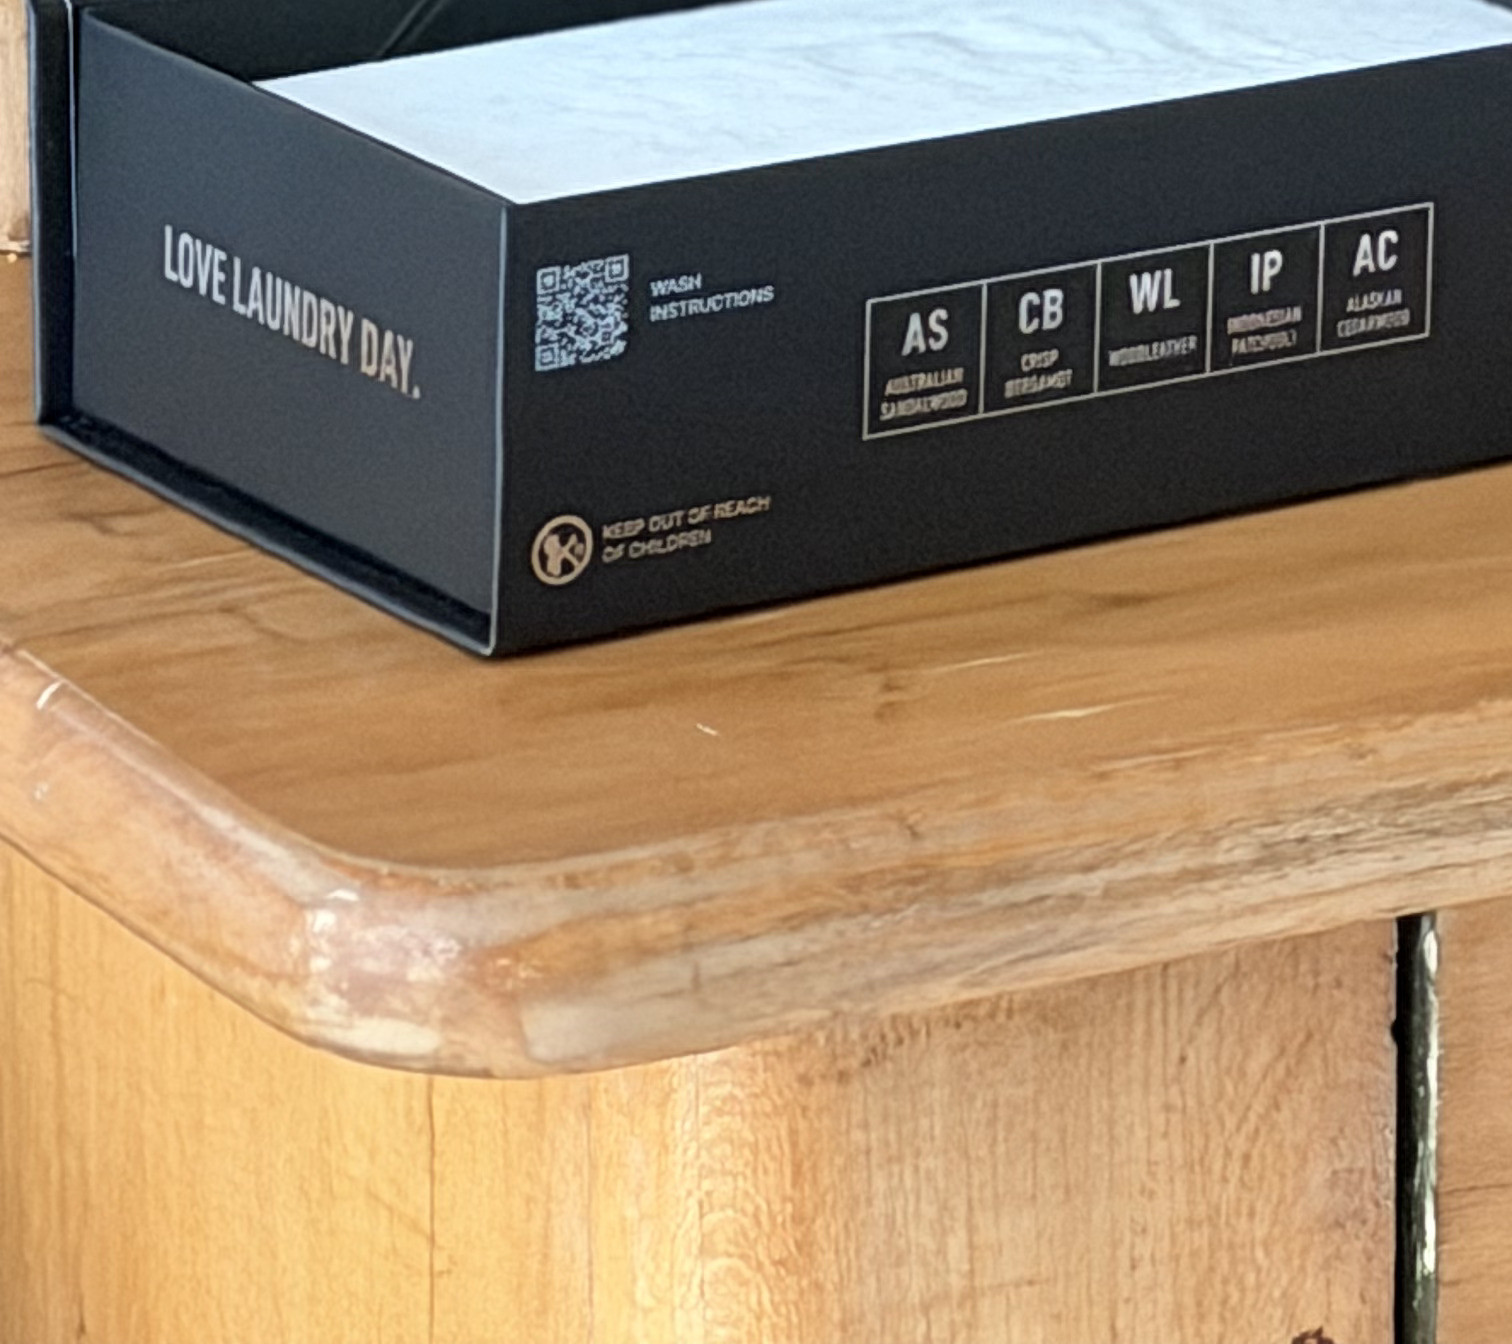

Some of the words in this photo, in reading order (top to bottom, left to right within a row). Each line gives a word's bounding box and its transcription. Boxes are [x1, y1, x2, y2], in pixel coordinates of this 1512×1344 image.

[1250, 249, 1283, 295] IP
[1353, 229, 1400, 277] AC
[650, 273, 702, 297] WASH
[650, 285, 775, 322] INSTRUCTIONS
[1129, 268, 1180, 315] WL
[1345, 289, 1403, 313] ALASKAN
[164, 224, 227, 305] LOVE
[233, 256, 354, 365] LAUNDRY
[360, 318, 420, 400] DAY.
[901, 308, 949, 356] AS
[1018, 288, 1064, 334] CB
[1020, 348, 1060, 372] CRISP
[602, 518, 645, 539] KEEP
[649, 510, 684, 533] OUT
[686, 505, 714, 525] OF
[713, 495, 771, 520] REACH
[602, 544, 627, 563] OF
[628, 529, 712, 559] CHILDREN
